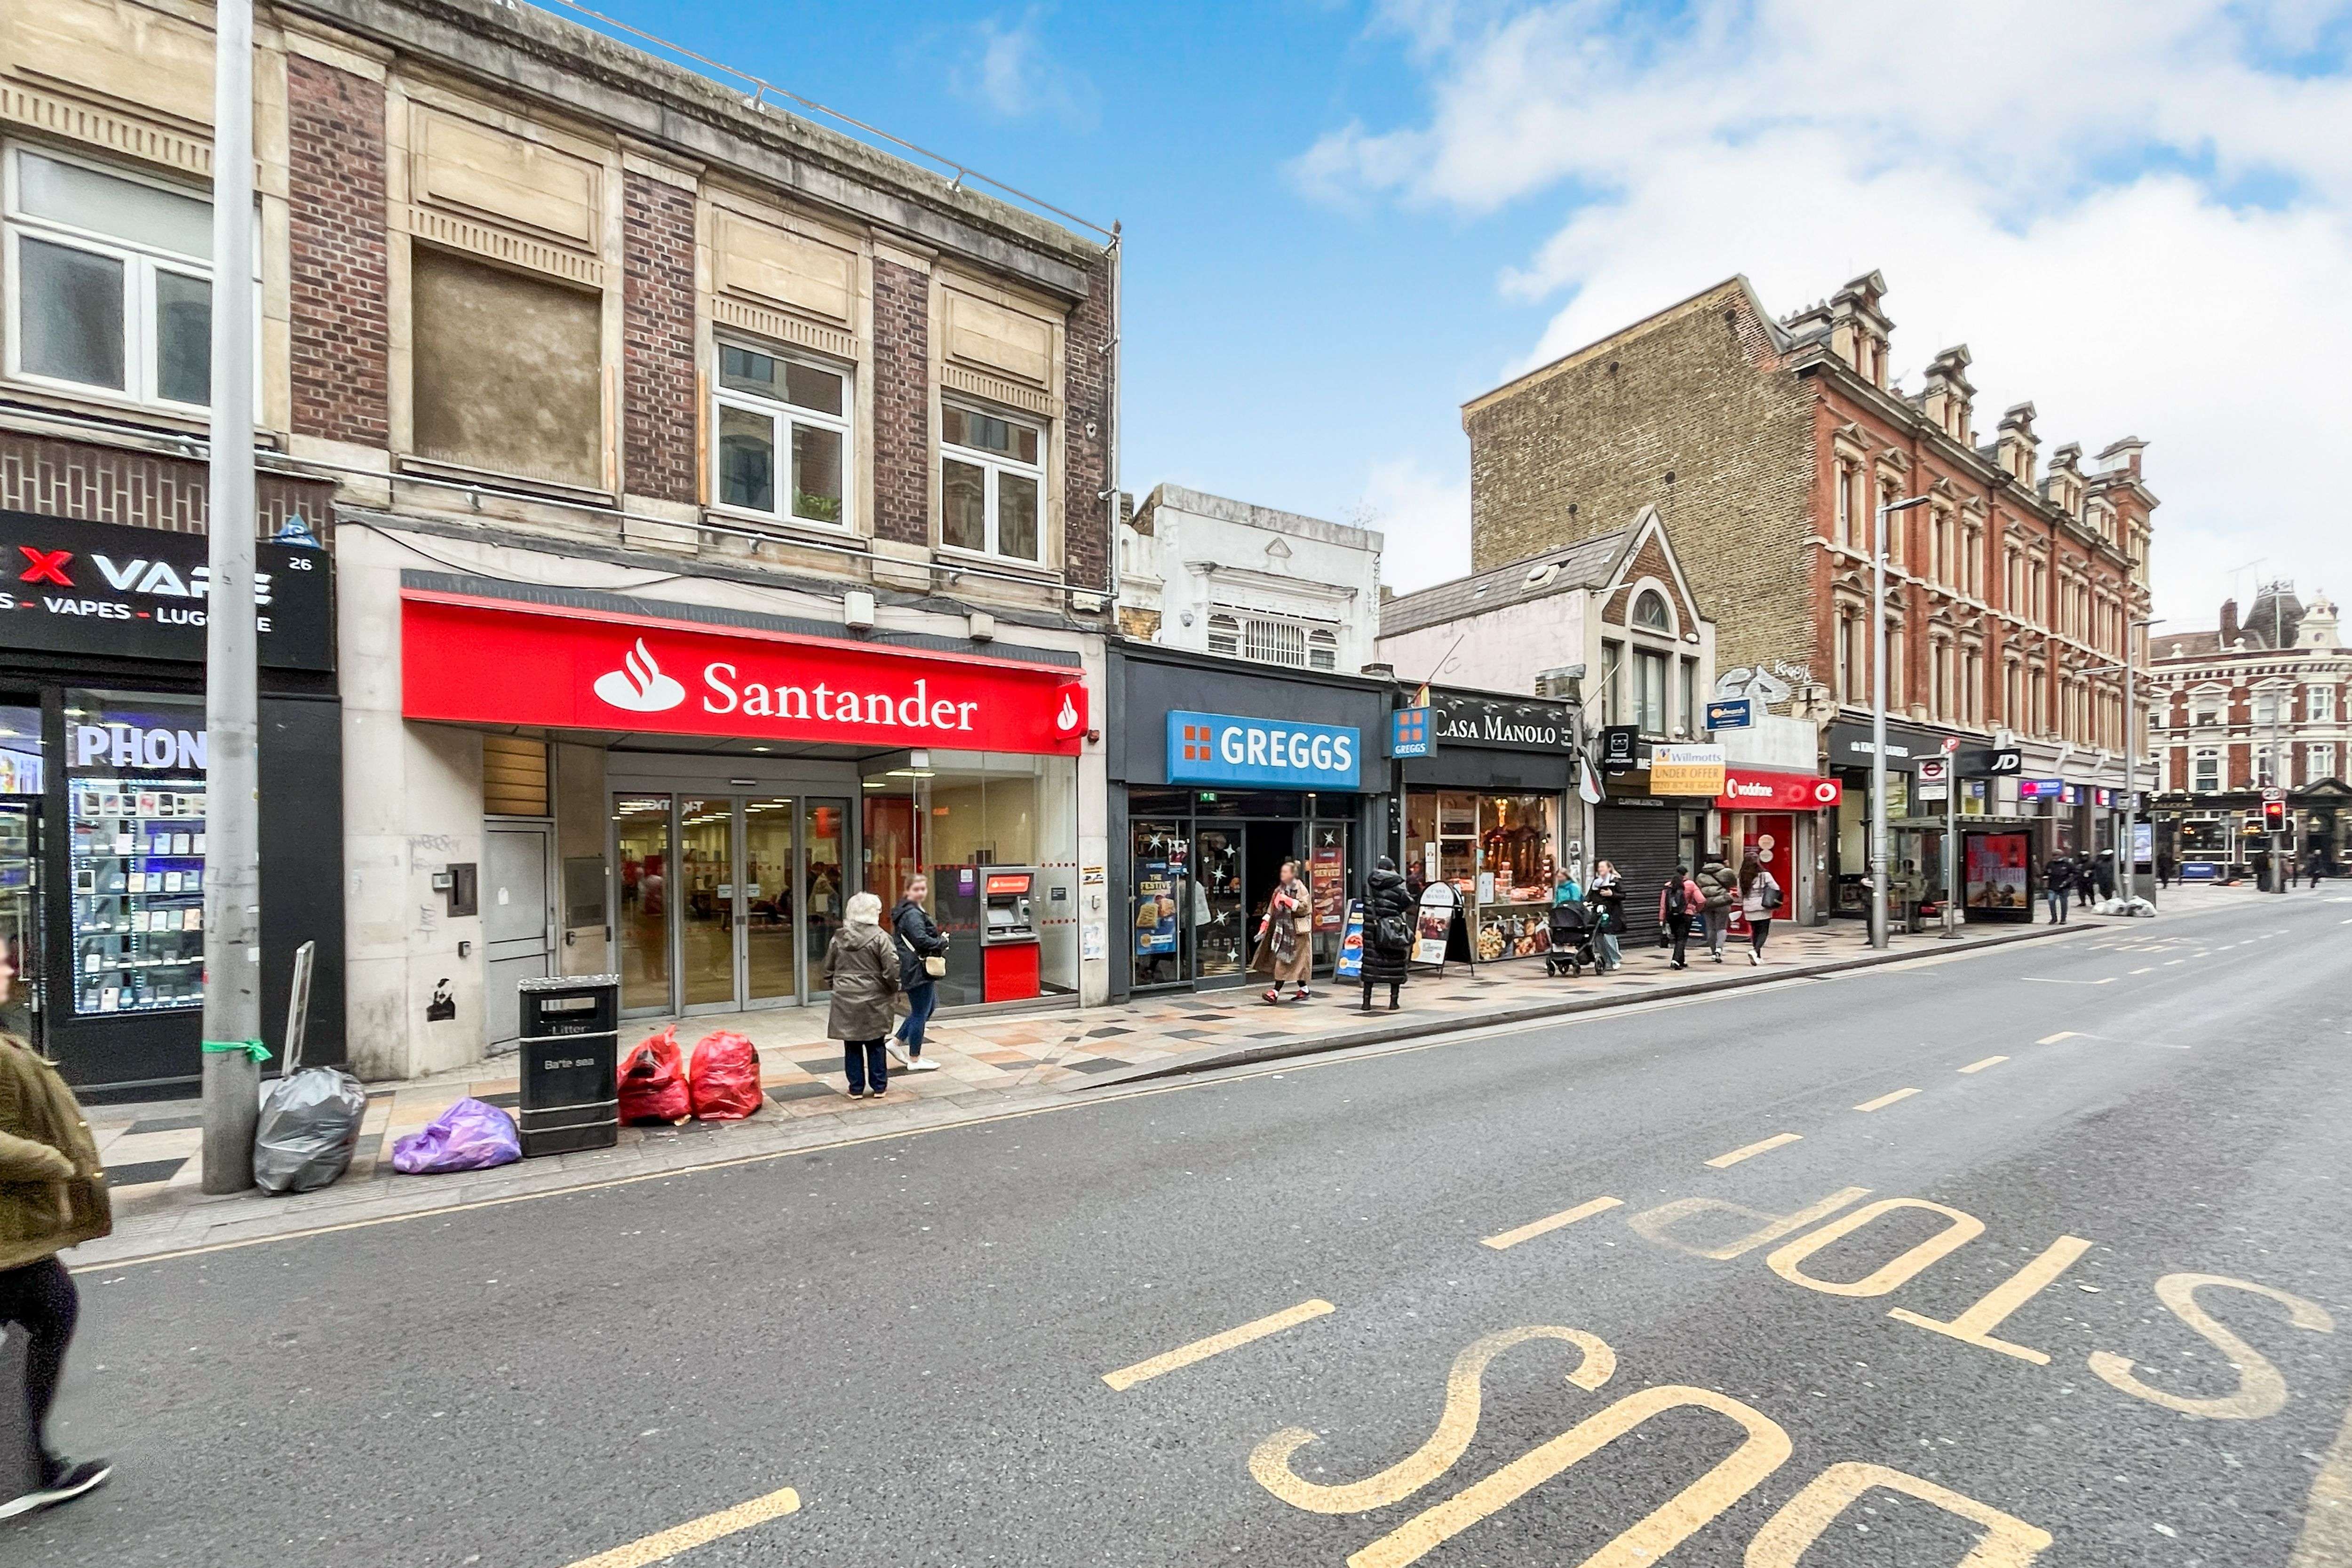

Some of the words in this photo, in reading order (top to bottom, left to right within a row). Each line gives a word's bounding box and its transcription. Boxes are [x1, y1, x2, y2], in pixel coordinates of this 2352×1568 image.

[18, 546, 76, 587] X
[289, 557, 312, 571] 26
[42, 596, 131, 620] VAPES
[157, 607, 271, 632] LUGE
[703, 662, 977, 731] Santander
[1484, 715, 1556, 744] MANOLO
[78, 726, 207, 768] PHON
[1221, 726, 1351, 771] GREGGS
[1395, 743, 1426, 754] GREGGS
[1672, 753, 1721, 762] Willmotts
[1991, 754, 2019, 771] JD
[1655, 768, 1687, 778] UNDER
[1690, 768, 1719, 778] OFFER
[1738, 782, 1773, 797] vodafone
[1140, 881, 1171, 890] FESTIVE
[552, 1025, 587, 1035] Litter
[1628, 1186, 2335, 1420] STOP
